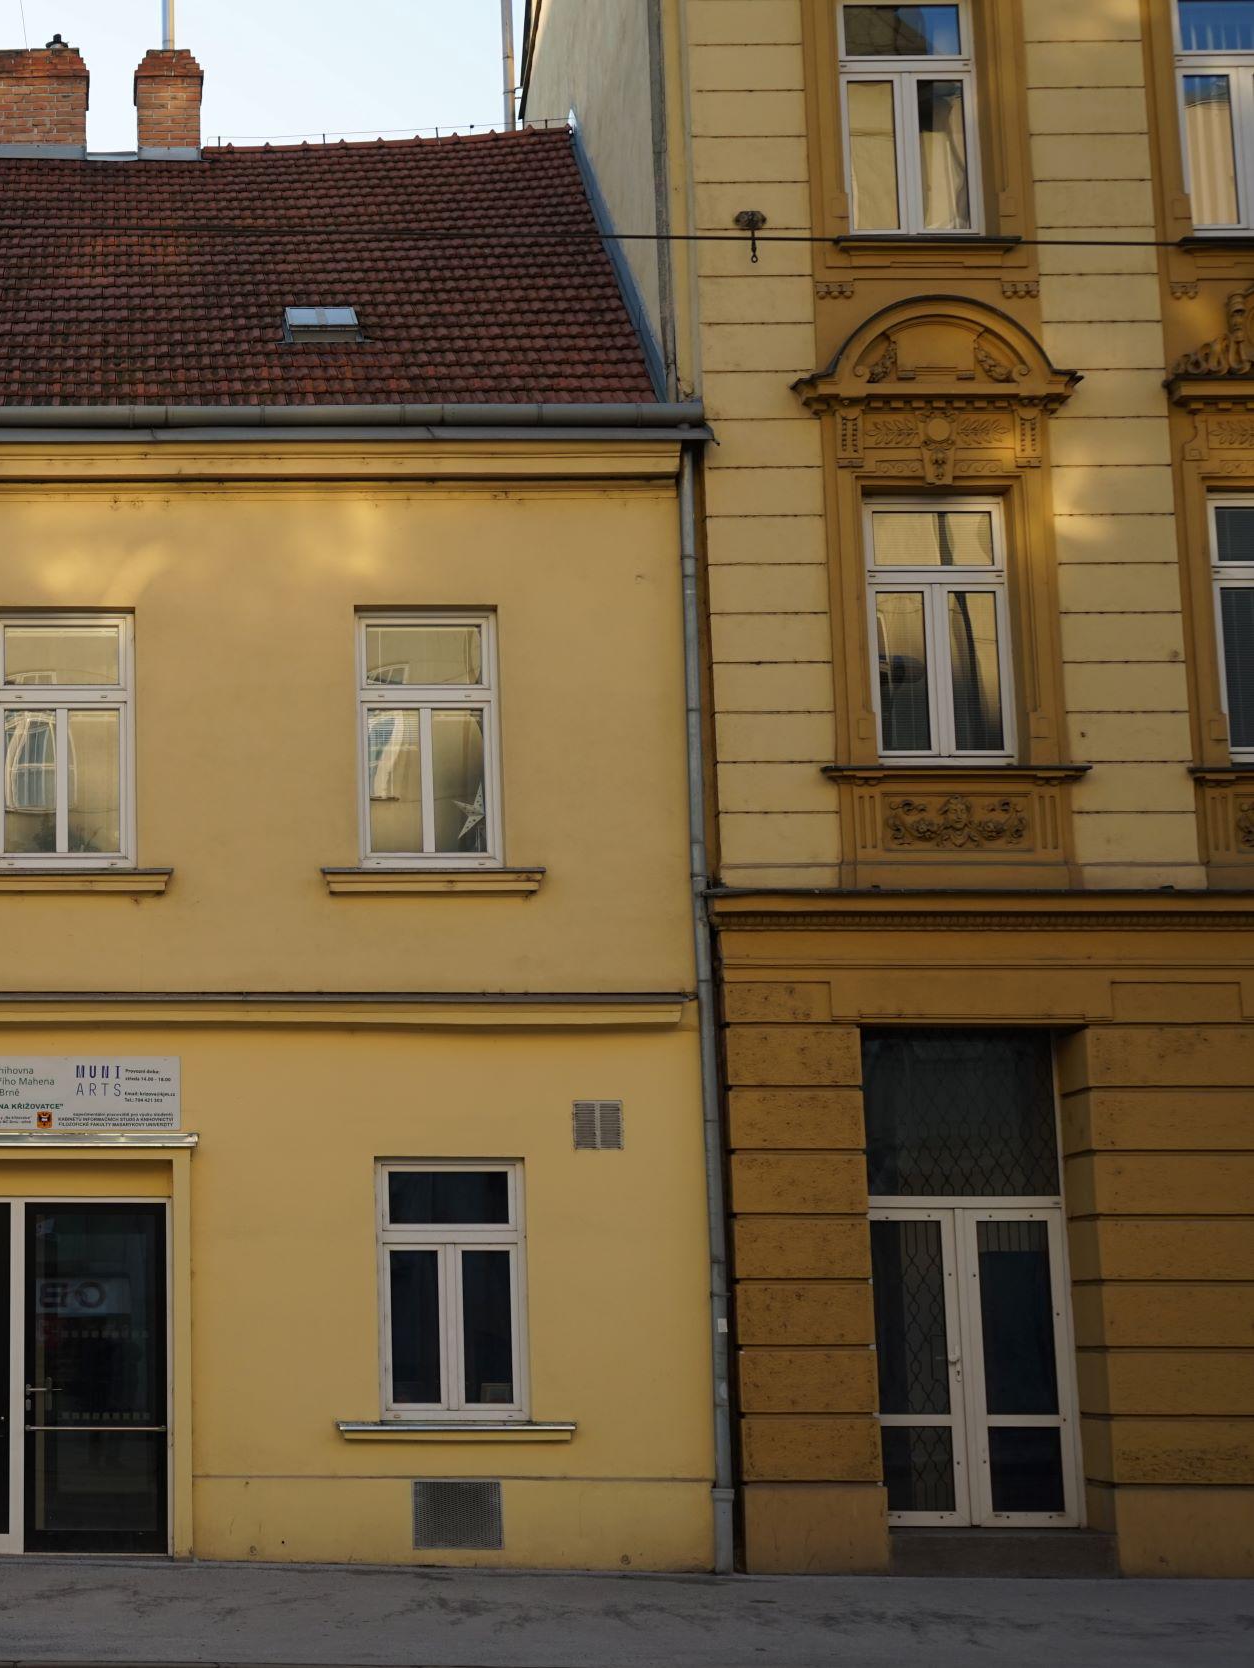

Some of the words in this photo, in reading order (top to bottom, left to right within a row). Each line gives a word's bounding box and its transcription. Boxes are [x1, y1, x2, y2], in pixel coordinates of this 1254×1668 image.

[76, 1065, 121, 1079] MUNI
[19, 1077, 55, 1086] Mahena
[76, 1083, 122, 1097] ARTS
